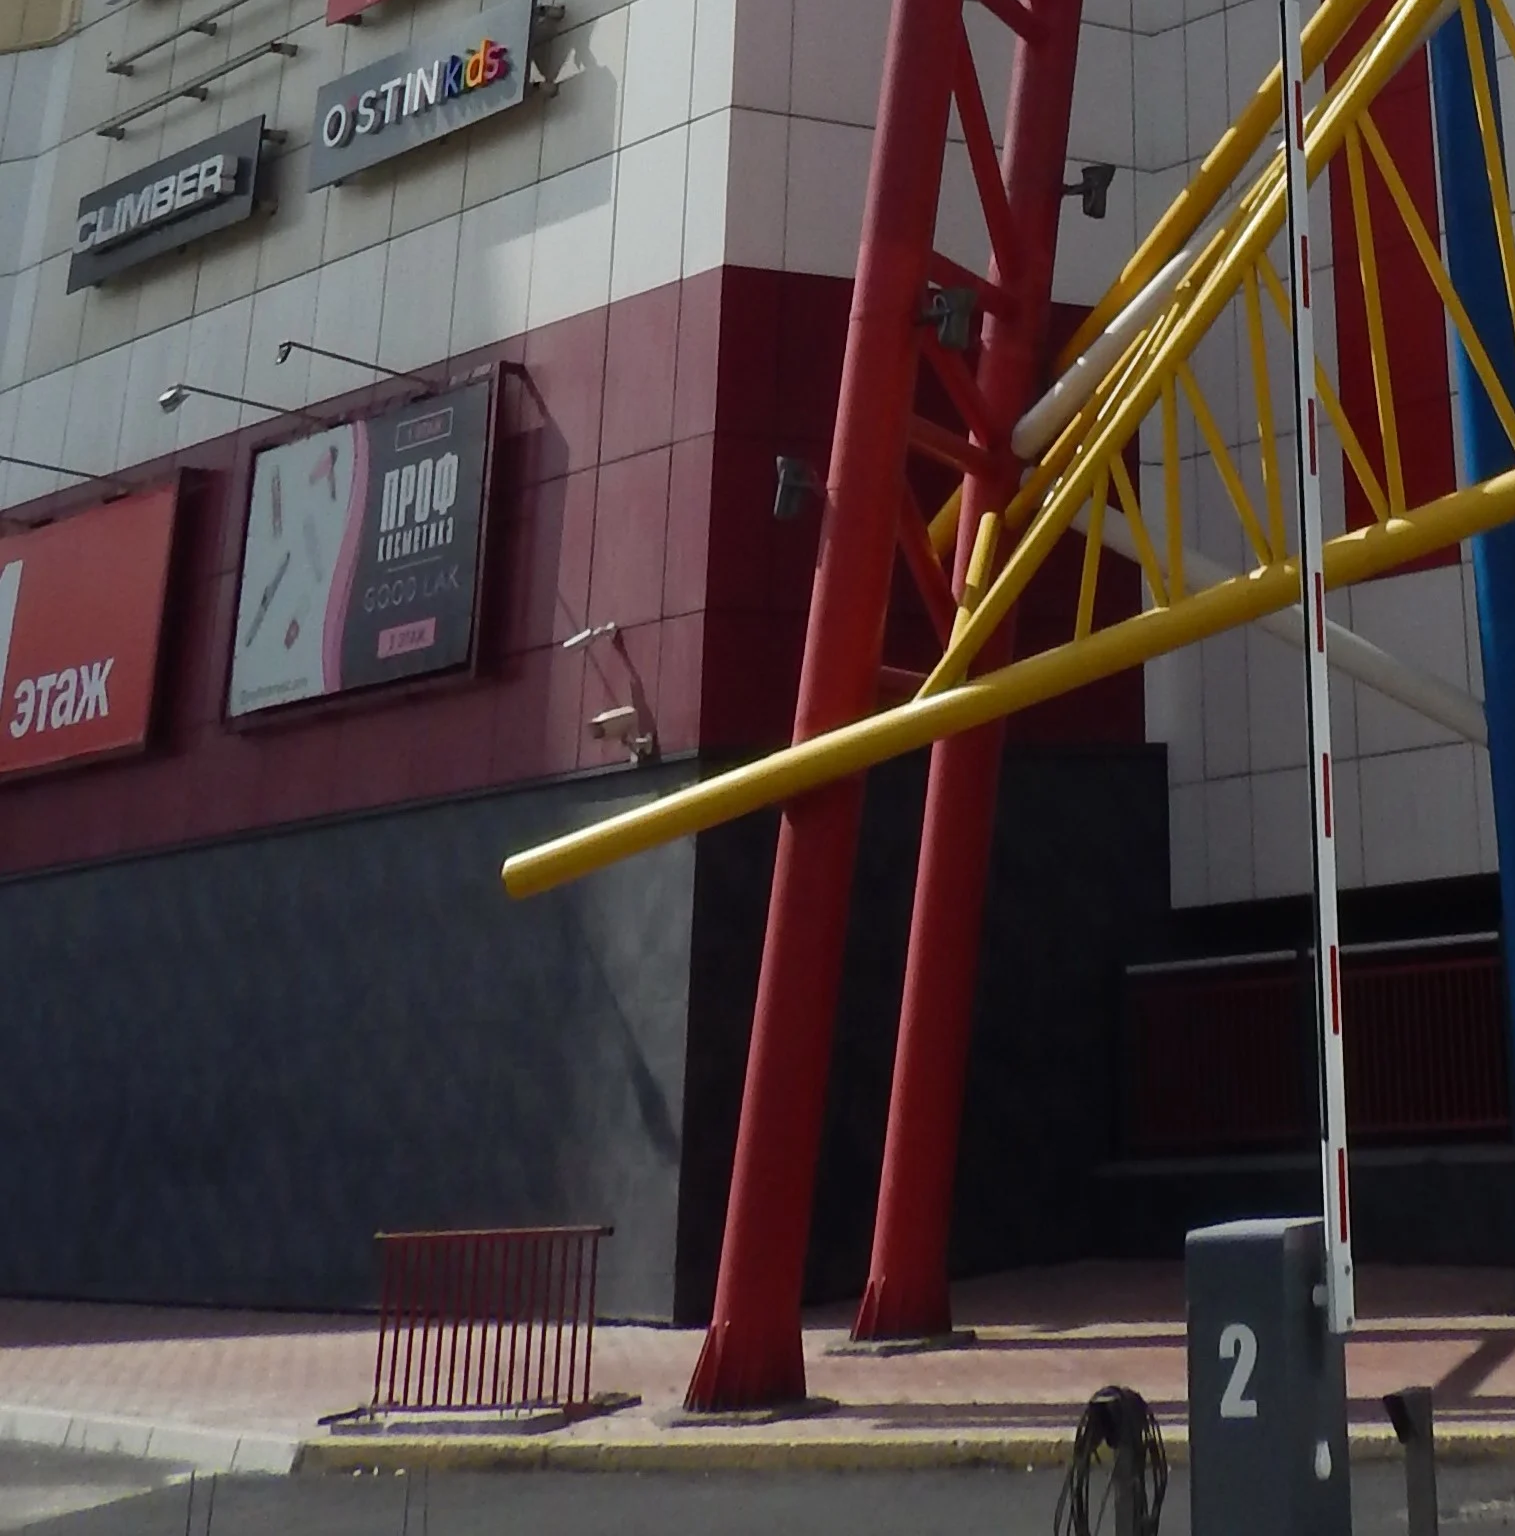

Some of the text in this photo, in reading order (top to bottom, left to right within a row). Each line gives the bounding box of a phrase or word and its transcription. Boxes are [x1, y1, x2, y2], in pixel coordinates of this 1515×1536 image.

[443, 38, 508, 98] kids
[72, 154, 226, 254] CLIMBER
[380, 452, 459, 533] ПРОФ
[10, 657, 114, 738] этаж
[1219, 1323, 1257, 1418] 2
